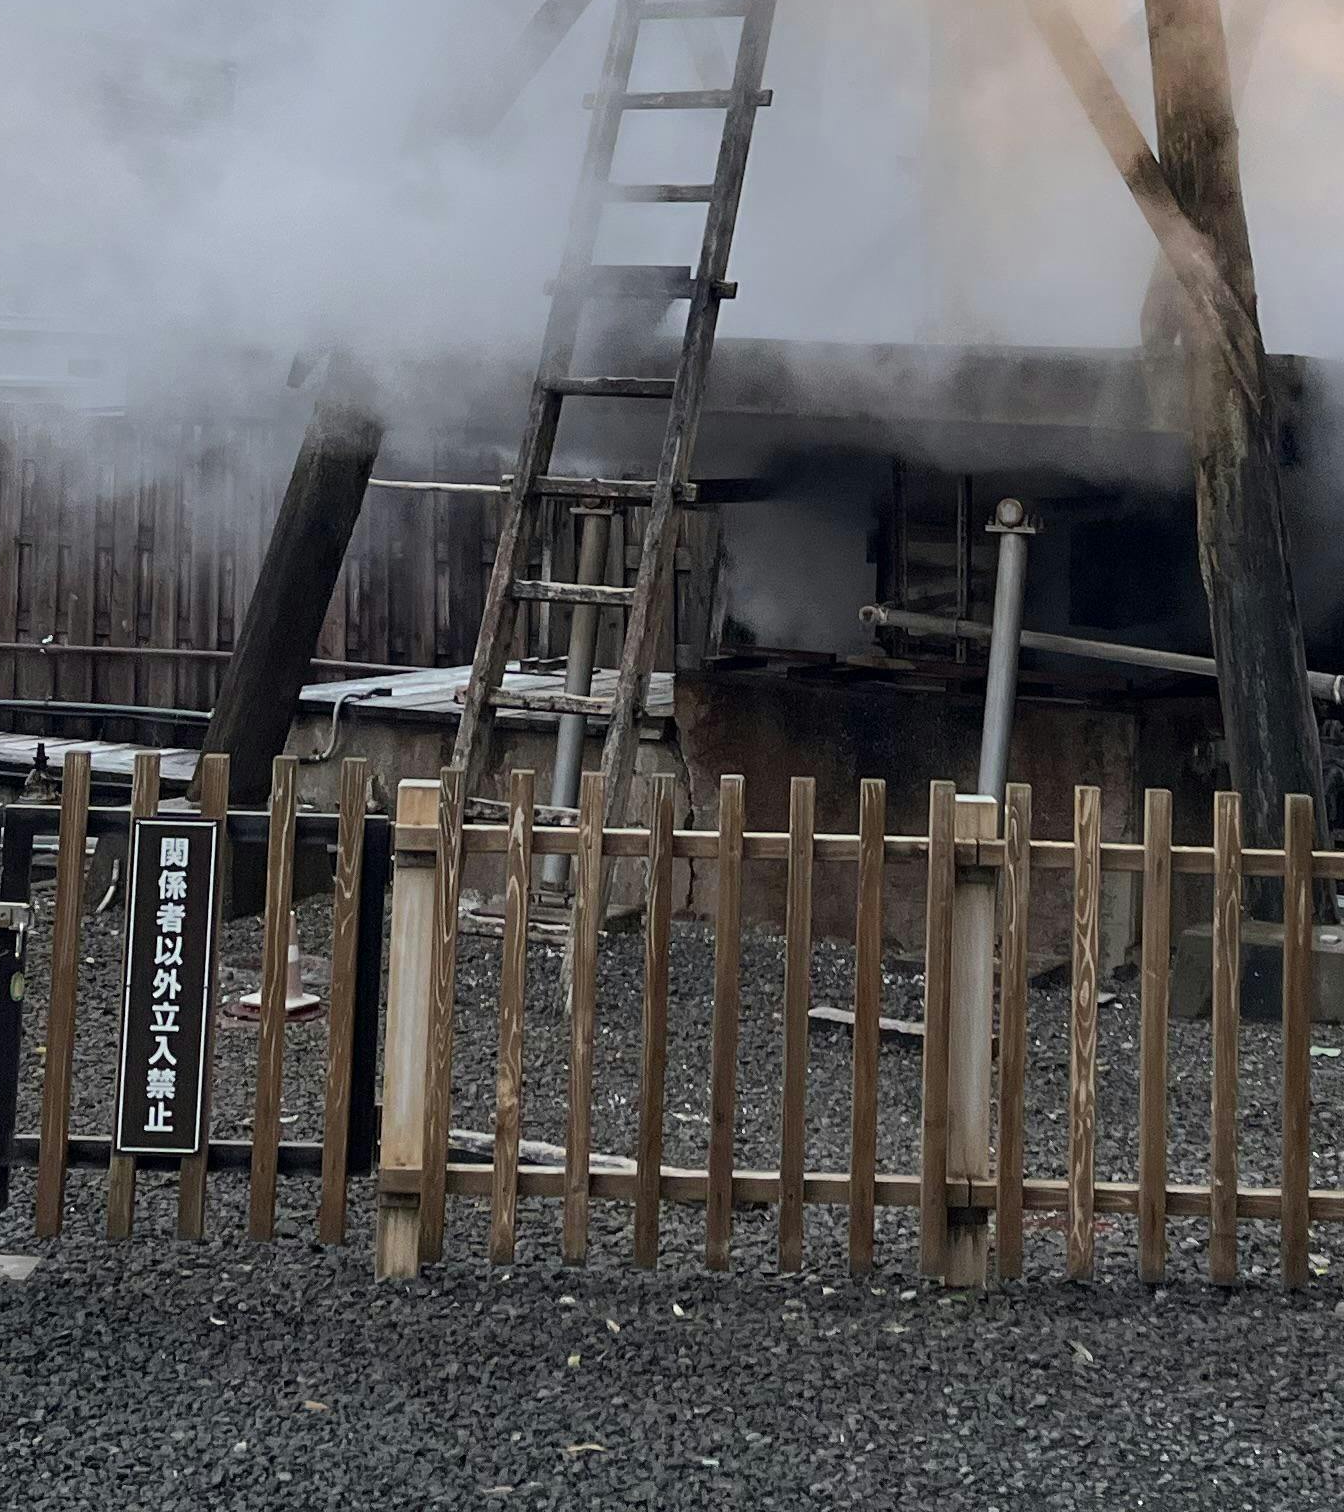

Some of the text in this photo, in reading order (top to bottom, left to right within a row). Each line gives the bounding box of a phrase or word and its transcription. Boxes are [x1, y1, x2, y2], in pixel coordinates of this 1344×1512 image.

[144, 837, 190, 1132] 関係者以外立入禁止
